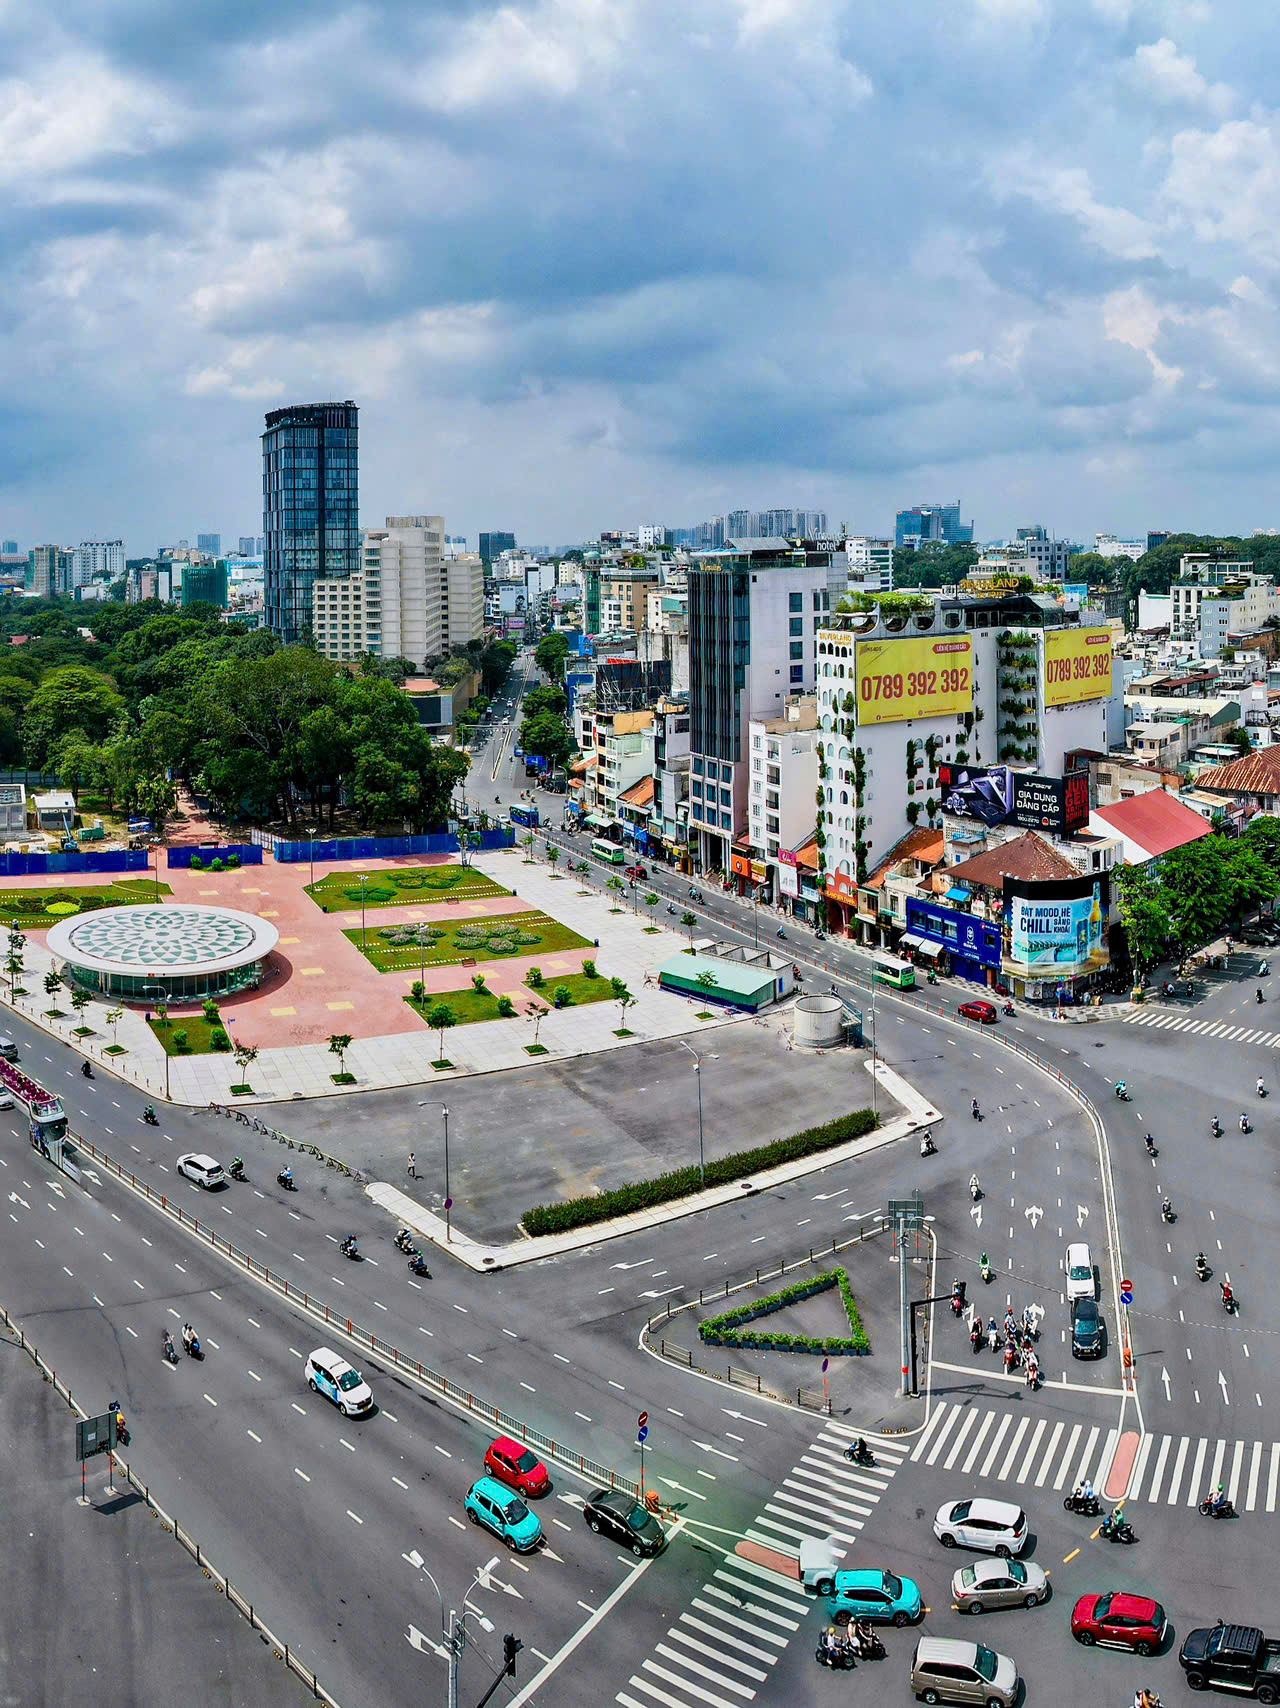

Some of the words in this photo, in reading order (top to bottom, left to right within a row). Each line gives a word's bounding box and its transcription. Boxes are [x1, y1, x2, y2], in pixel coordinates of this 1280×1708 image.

[816, 540, 837, 551] hotel
[1047, 658, 1071, 683] 0789
[1073, 655, 1090, 679] 392
[1092, 653, 1110, 677] 392
[861, 673, 904, 701] 0789
[907, 670, 937, 697] 392
[940, 667, 969, 693] 392
[1018, 790, 1032, 800] GIA
[1035, 908, 1059, 917] MOOD
[1020, 917, 1052, 933] CHILL
